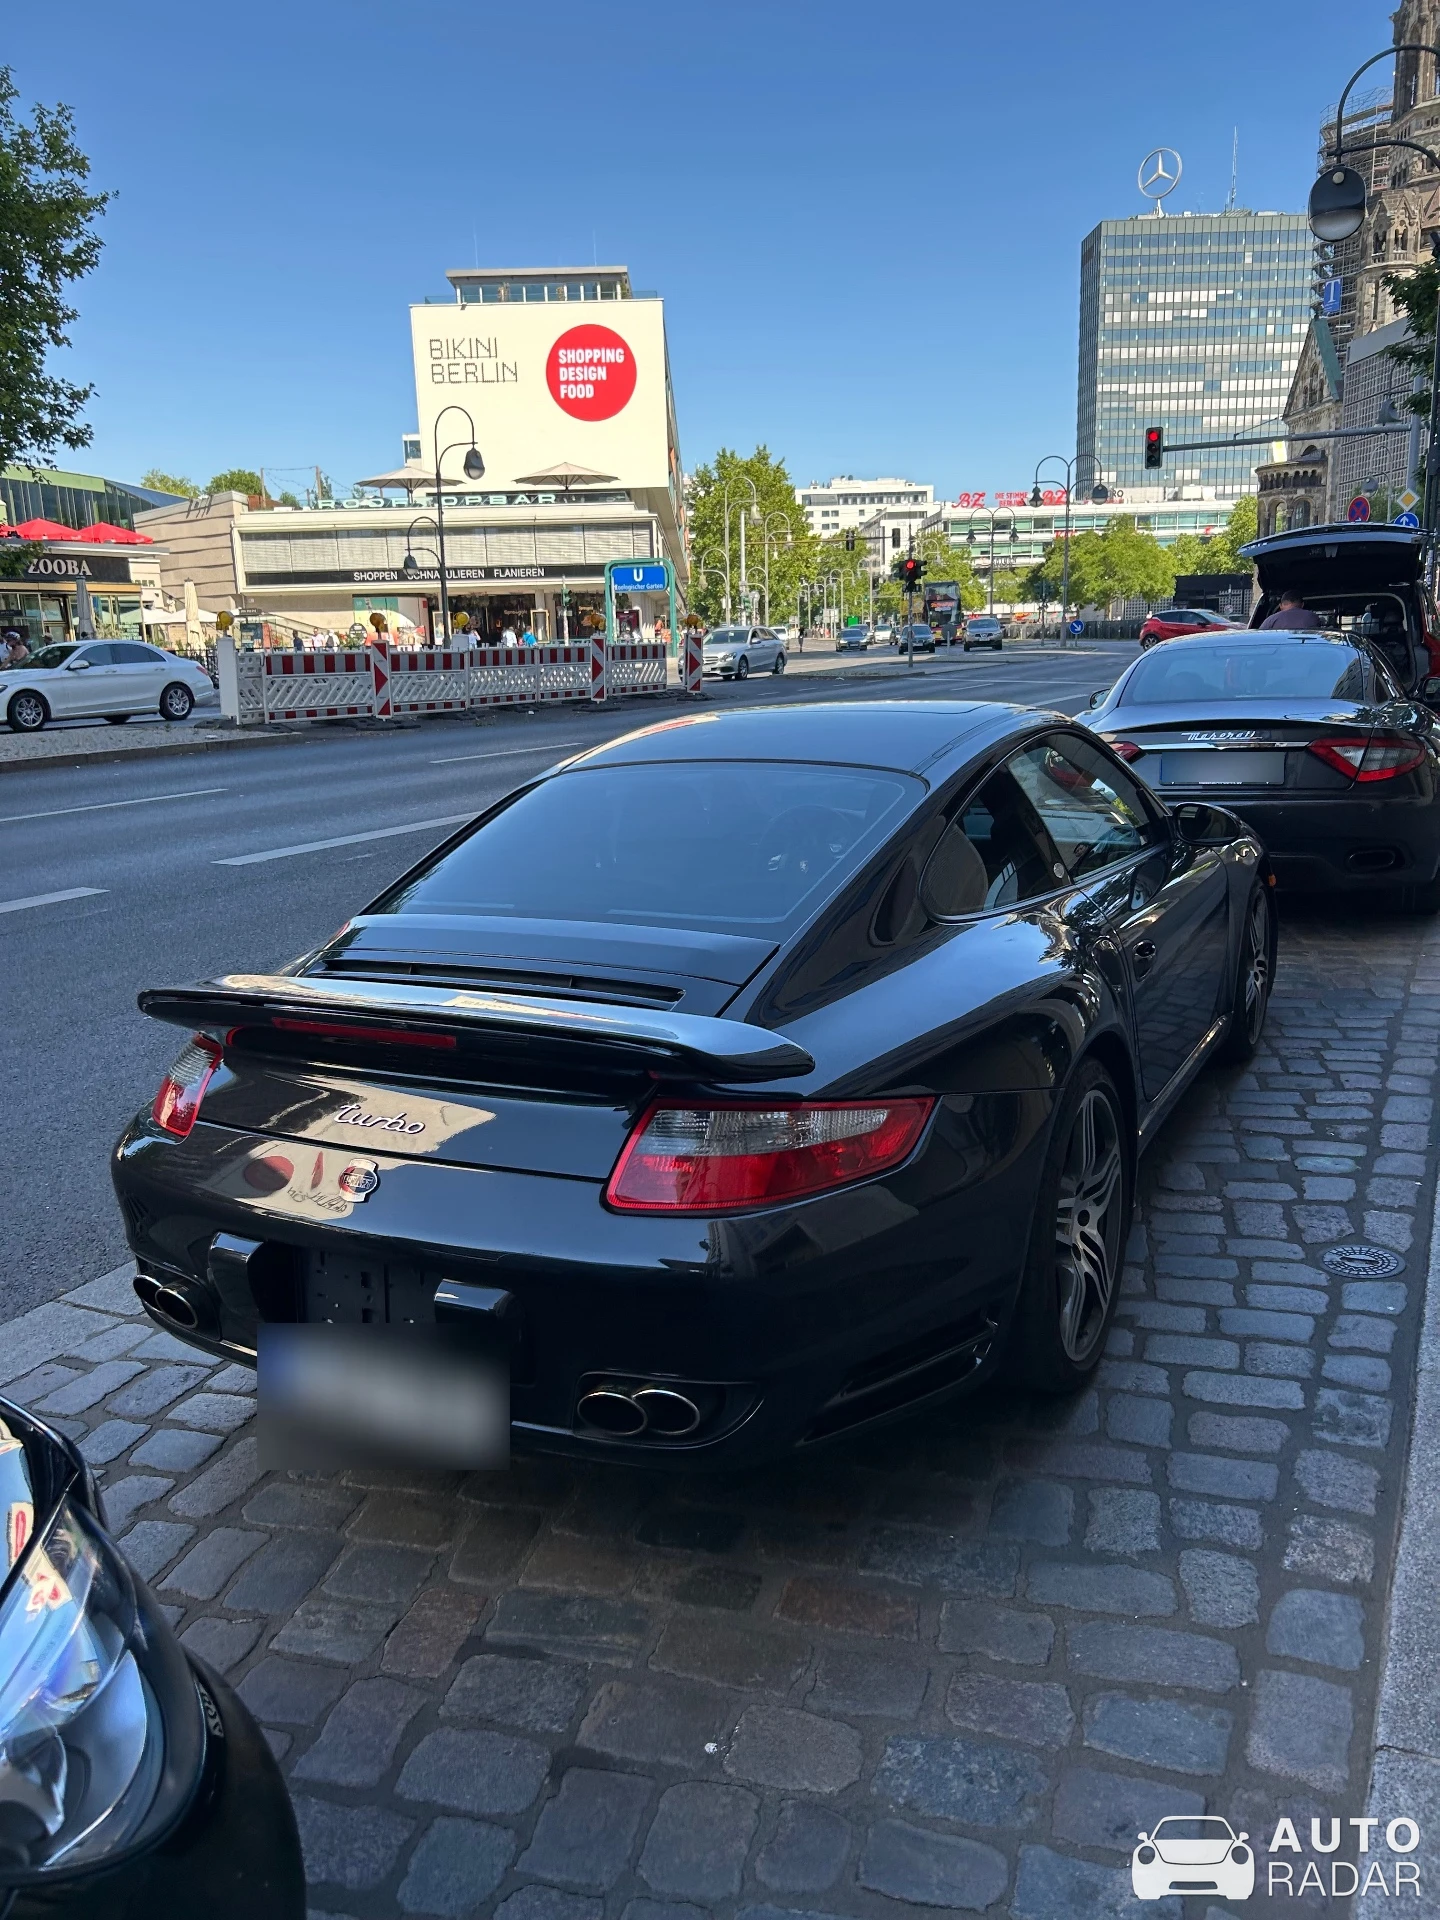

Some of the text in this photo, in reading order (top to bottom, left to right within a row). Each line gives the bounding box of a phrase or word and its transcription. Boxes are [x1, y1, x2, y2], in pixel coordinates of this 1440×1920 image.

[429, 337, 498, 359] BIKINI
[558, 347, 625, 364] SHOPPING
[431, 361, 518, 384] BERLIN
[559, 366, 607, 381] DESIGN
[560, 384, 594, 399] FOOD
[28, 558, 92, 576] ZOOBA
[353, 567, 545, 581] SHOPPEN CHNAULIEREN FLANIEREN
[633, 568, 643, 582] U
